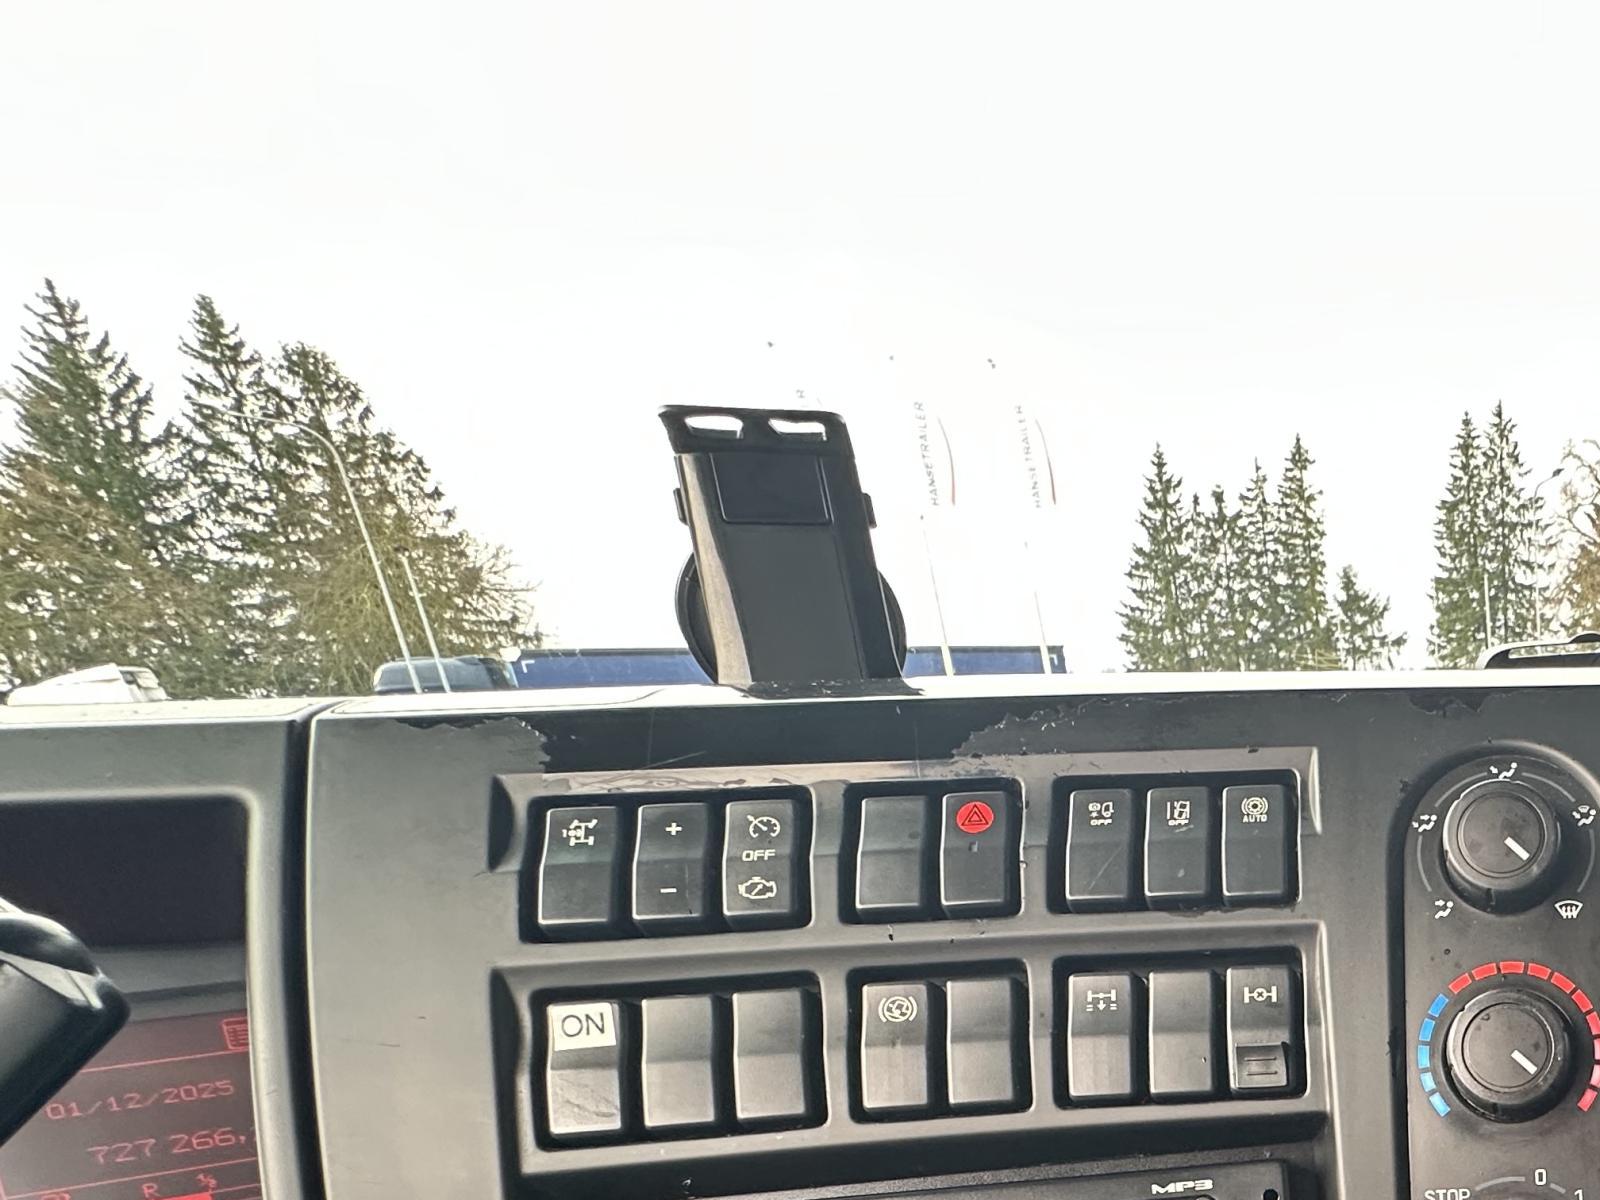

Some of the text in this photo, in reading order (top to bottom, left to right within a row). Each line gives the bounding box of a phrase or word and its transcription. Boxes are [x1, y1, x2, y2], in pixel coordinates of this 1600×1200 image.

[914, 401, 940, 506] HANSETRAILER
[1090, 818, 1113, 826] OFF
[1242, 814, 1268, 823] AUTO
[741, 849, 776, 862] OFF
[561, 1012, 605, 1038] ON
[46, 1079, 235, 1119] 01/12/2025
[87, 1138, 157, 1165] 727
[1534, 1169, 1547, 1186] 0
[142, 1183, 160, 1198] R
[1151, 1179, 1214, 1195] MP3
